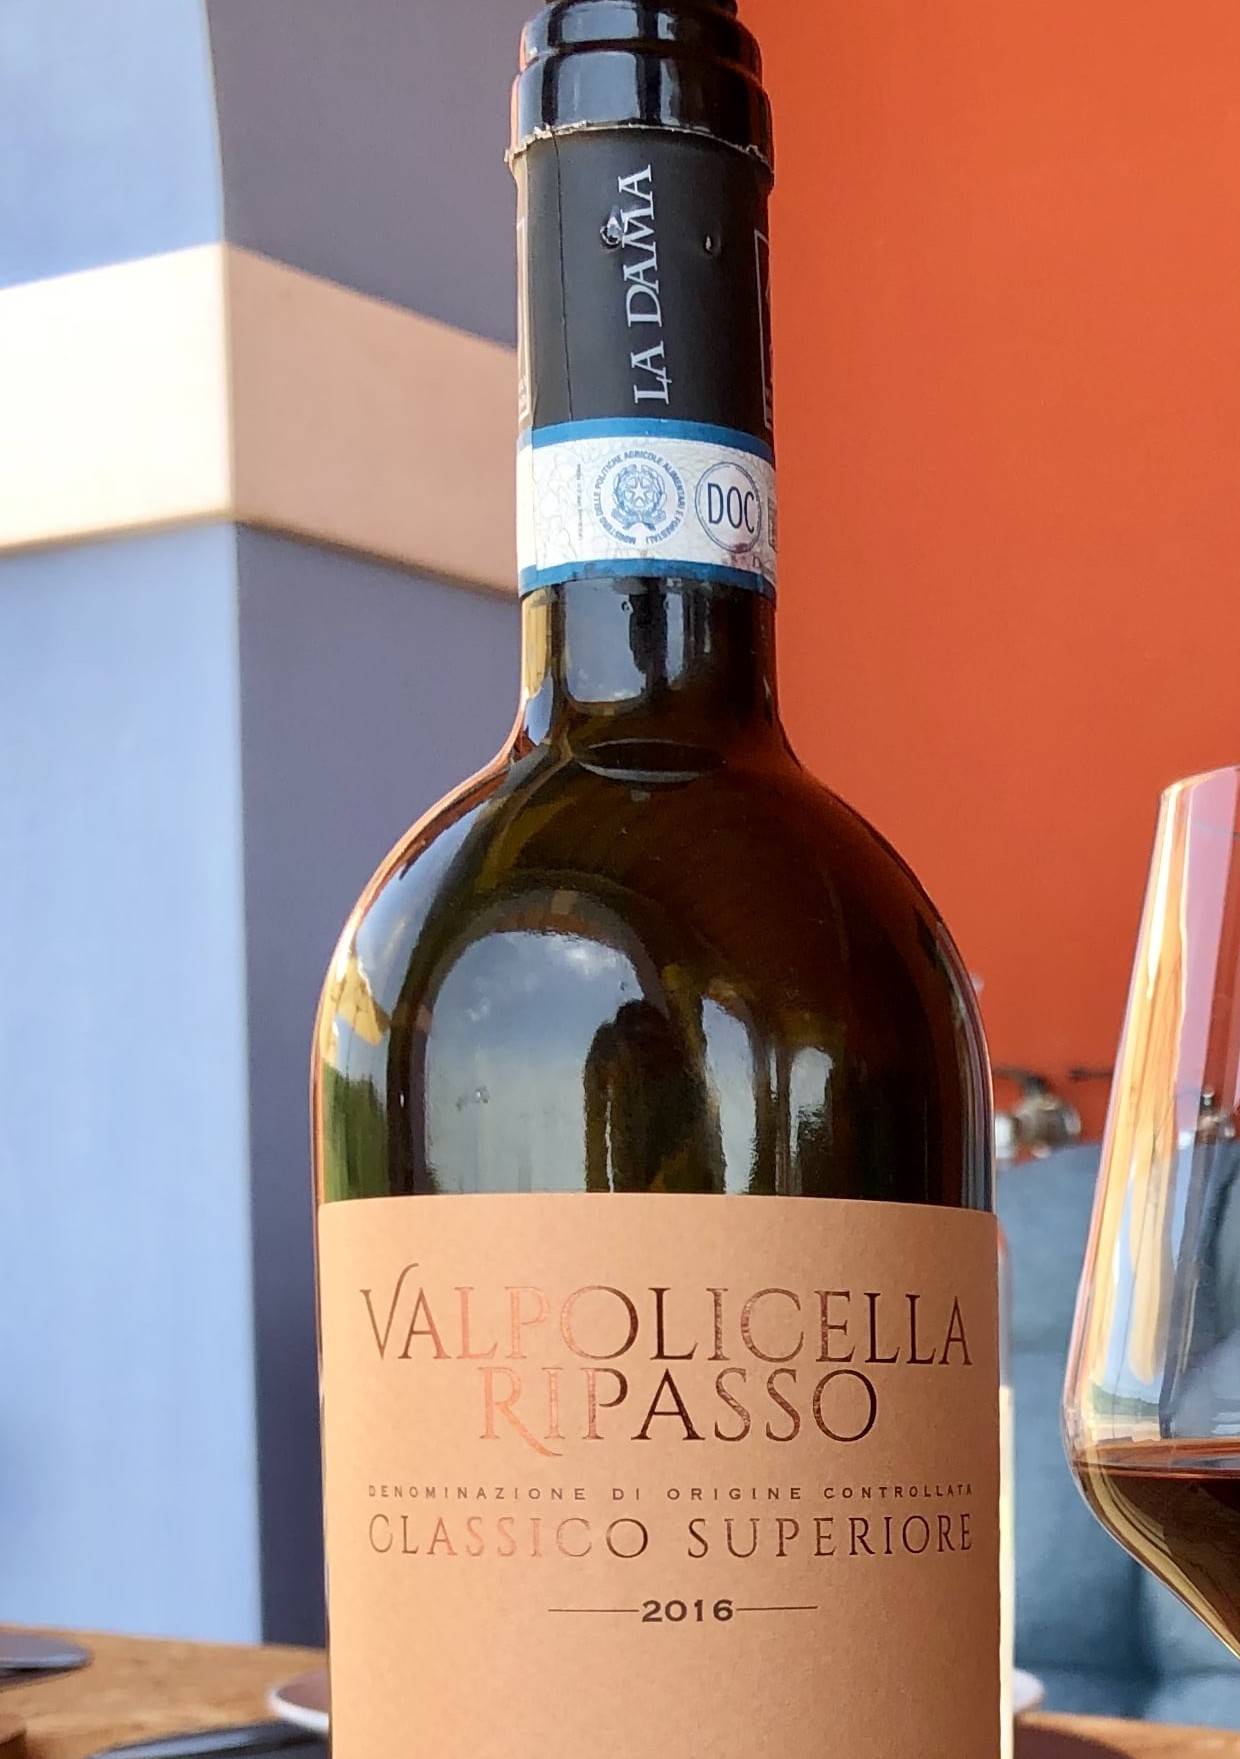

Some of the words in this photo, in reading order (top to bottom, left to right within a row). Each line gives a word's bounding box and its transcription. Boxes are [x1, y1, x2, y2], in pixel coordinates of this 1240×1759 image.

[617, 164, 665, 327] DAMA
[630, 341, 673, 405] LA
[707, 482, 755, 534] DOC
[359, 1262, 975, 1367] VALPOLICELLA
[478, 1365, 879, 1457] RIPASSO
[368, 1484, 587, 1501] DENOMINAZIONE
[612, 1487, 640, 1500] DI
[667, 1487, 801, 1500] ORIGINE
[824, 1483, 972, 1500] CONTROLLATA
[368, 1513, 649, 1559] CLASSICO
[687, 1513, 972, 1559] SUPERIORE
[641, 1598, 735, 1624] 2016
